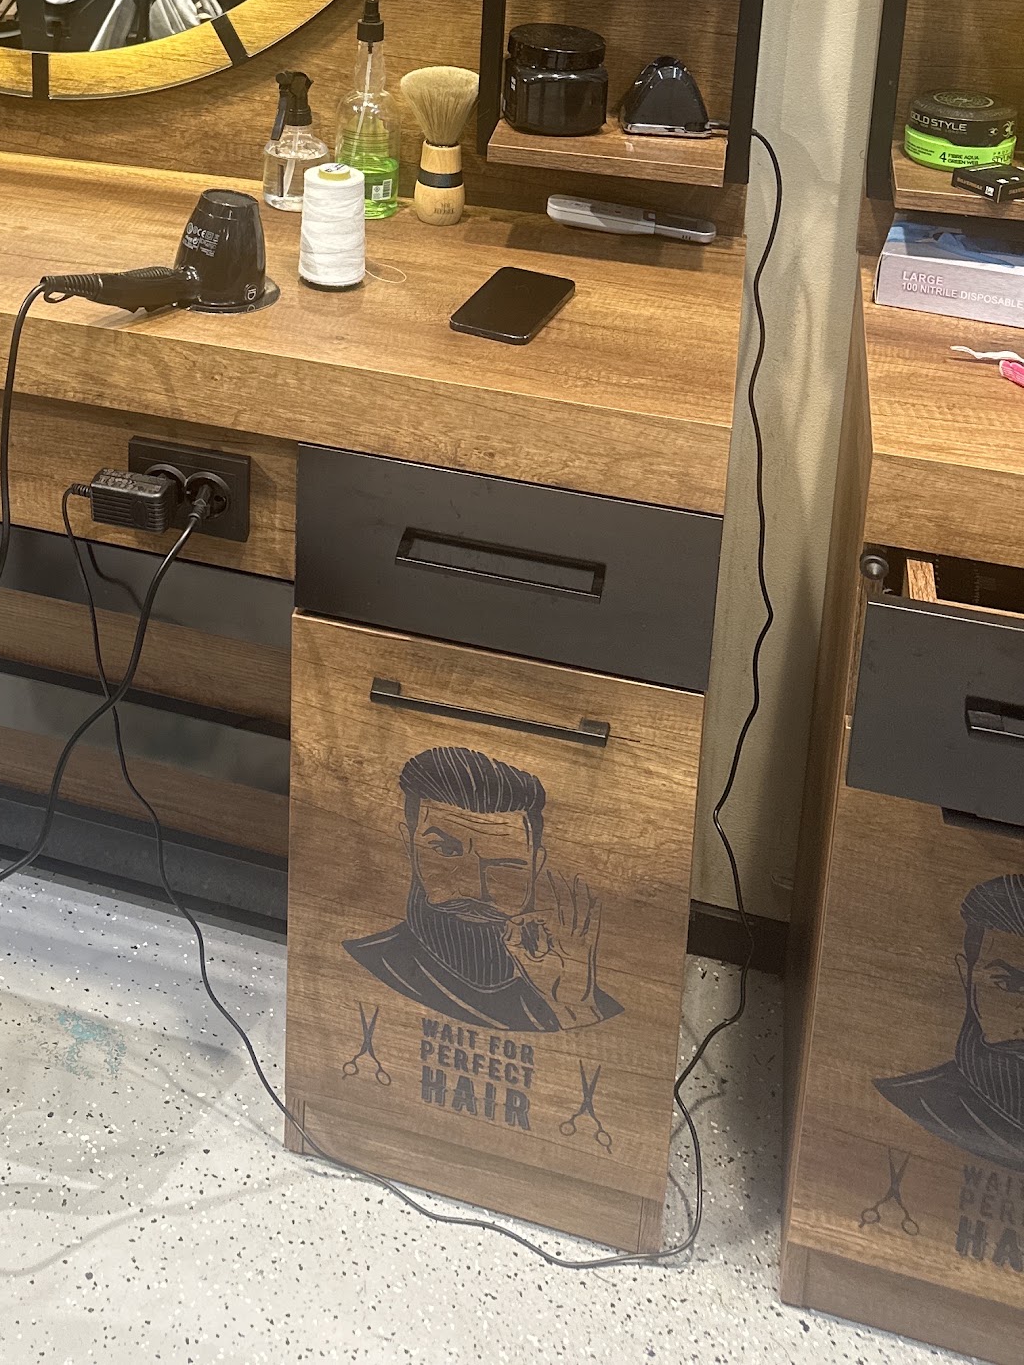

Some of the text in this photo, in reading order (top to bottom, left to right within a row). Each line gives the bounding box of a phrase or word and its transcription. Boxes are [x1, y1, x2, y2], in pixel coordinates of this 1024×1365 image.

[911, 111, 968, 132] GOLD STYLE
[939, 152, 947, 163] 4
[902, 270, 944, 286] LARGE
[902, 282, 1024, 309] 100 NITRILE DISPOSABLE
[421, 1017, 535, 1066] WAIT FOR
[420, 1040, 535, 1090] PERFECT
[420, 1065, 531, 1132] HAIR
[959, 1186, 1024, 1226] PER
[955, 1215, 1024, 1274] HA
